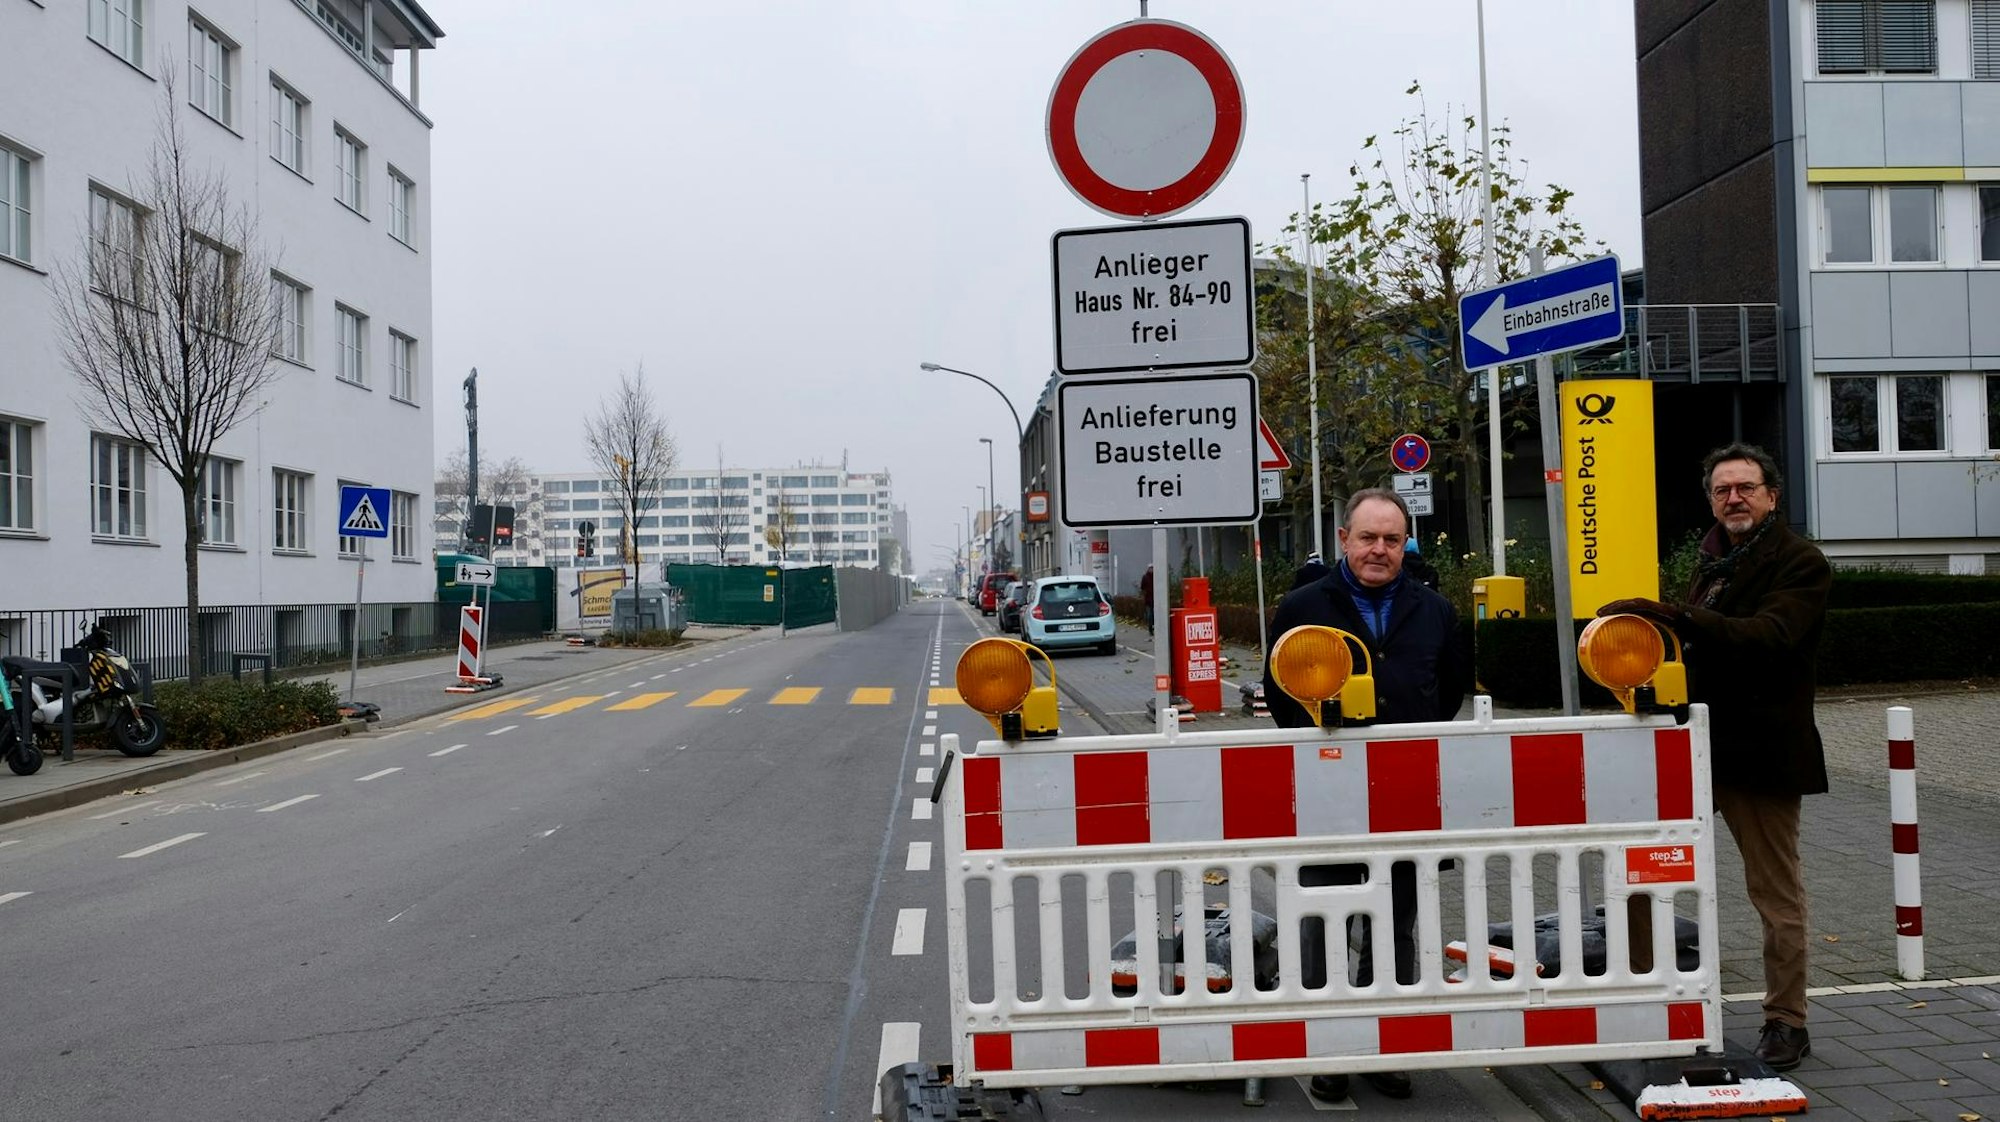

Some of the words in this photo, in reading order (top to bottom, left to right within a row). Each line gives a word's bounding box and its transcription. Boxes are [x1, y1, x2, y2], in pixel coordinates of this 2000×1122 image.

[1094, 253, 1209, 280] Anlieger
[1075, 291, 1122, 313] Haus
[1133, 287, 1159, 310] Nr.
[1169, 280, 1231, 307] 84-90
[1504, 292, 1610, 331] Einbahnstraße
[1132, 318, 1177, 343] frei
[1081, 404, 1236, 430] Anlieferung
[1096, 437, 1221, 464] Baustelle
[1578, 436, 1595, 478] Post
[1137, 474, 1182, 498] frei
[1578, 484, 1598, 574] Deutsche
[1188, 669, 1217, 681] EXPRESS
[1649, 852, 1671, 862] step
[1708, 1088, 1741, 1098] step
